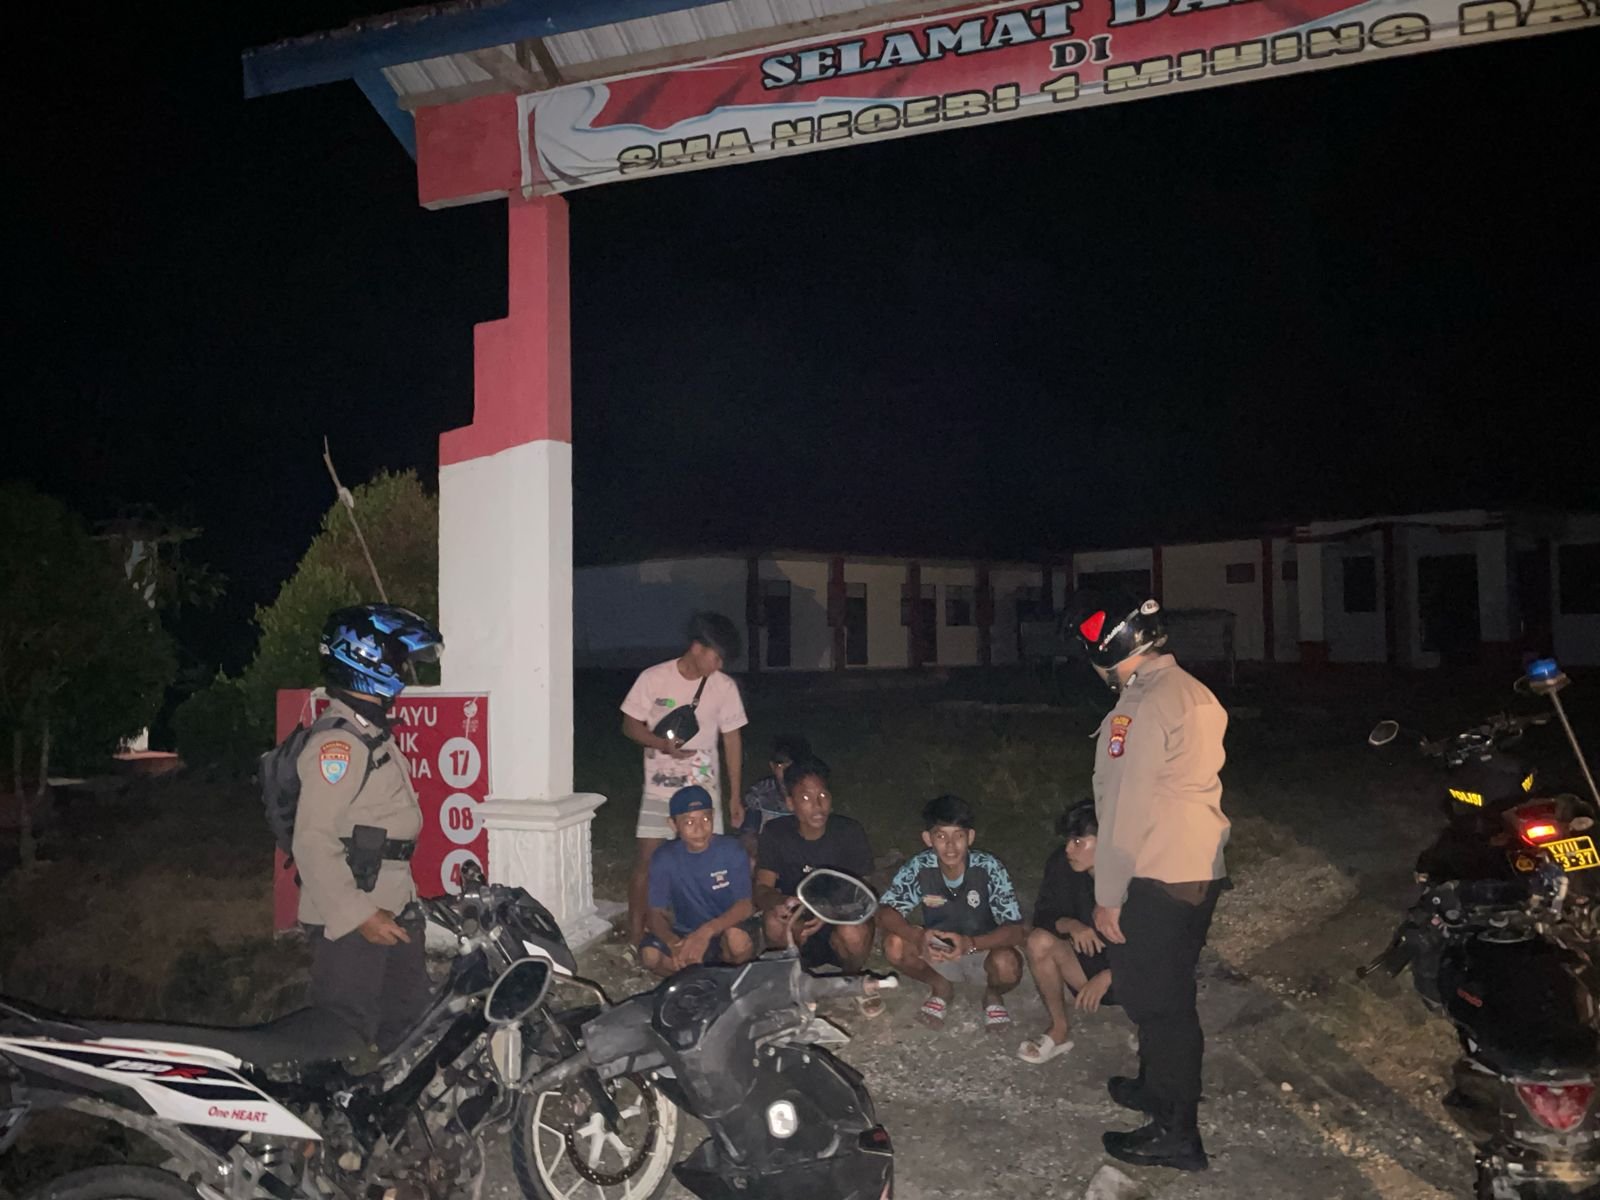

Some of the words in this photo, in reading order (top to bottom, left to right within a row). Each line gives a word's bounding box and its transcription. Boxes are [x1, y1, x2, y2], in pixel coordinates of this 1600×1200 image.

[761, 1, 1082, 90] SELAMAT
[1053, 36, 1111, 69] DI
[617, 127, 755, 174] SMA
[1040, 72, 1080, 100] 1
[1458, 0, 1600, 36] RA
[449, 750, 470, 776] 17
[447, 806, 474, 831] 08
[1547, 840, 1580, 855] XVIII
[208, 1106, 230, 1119] One
